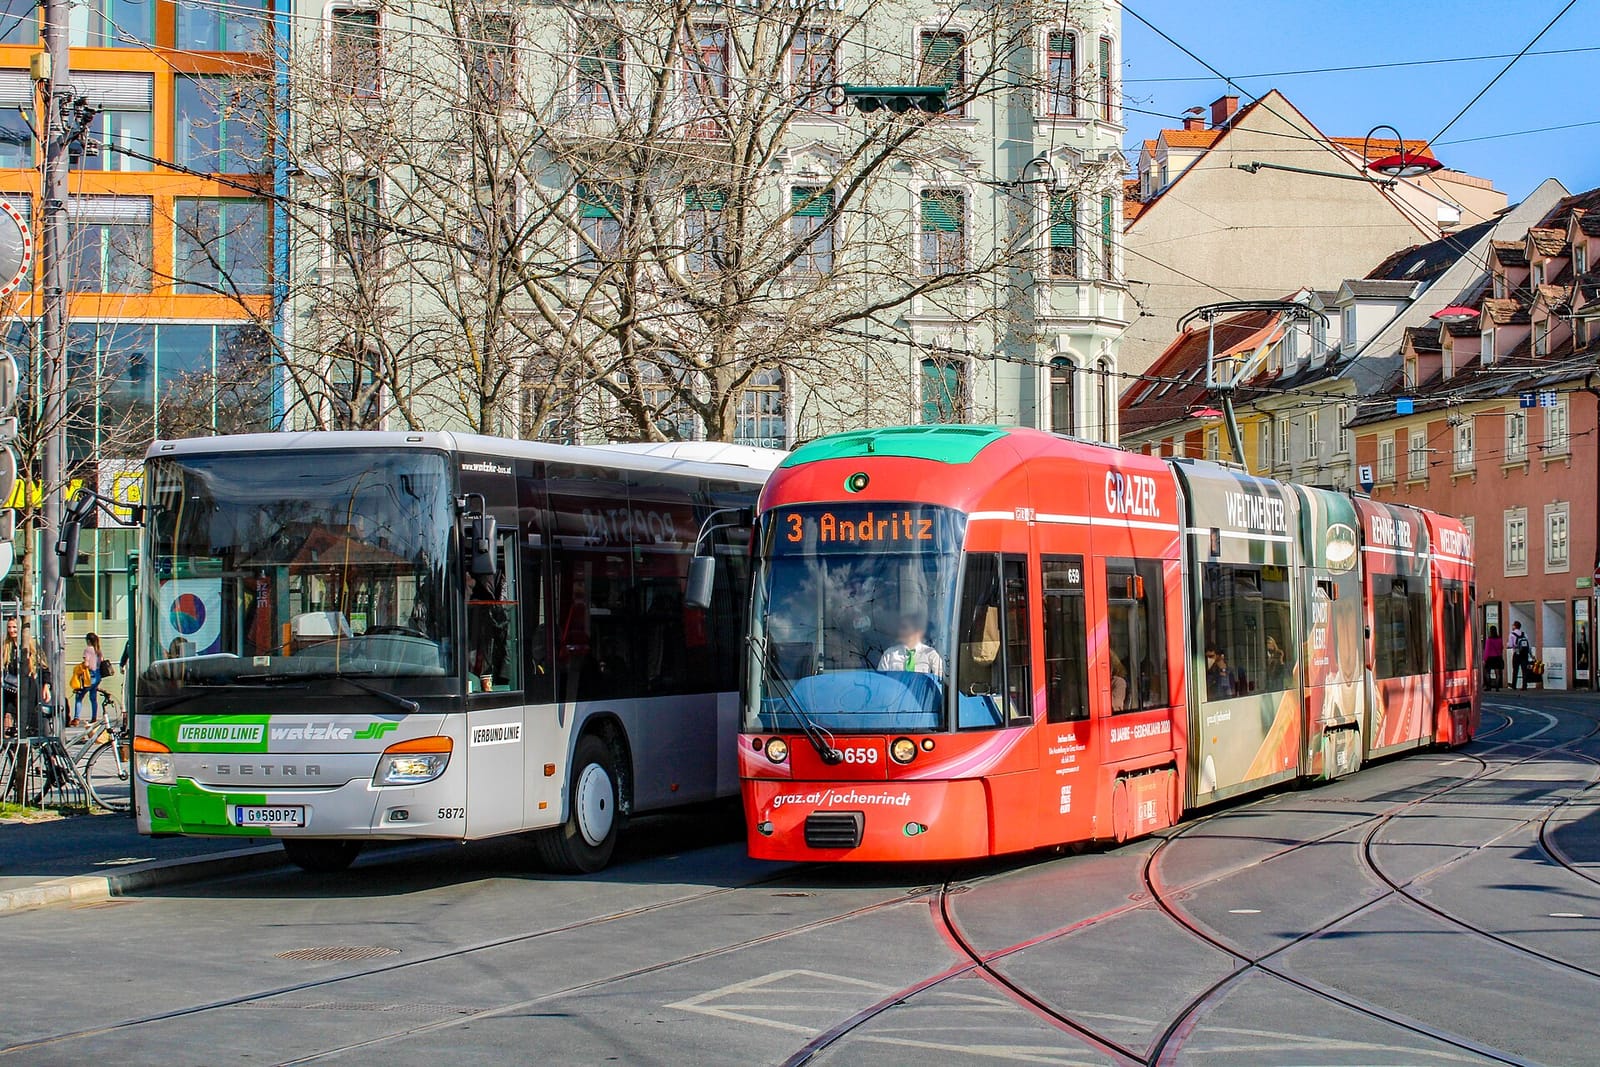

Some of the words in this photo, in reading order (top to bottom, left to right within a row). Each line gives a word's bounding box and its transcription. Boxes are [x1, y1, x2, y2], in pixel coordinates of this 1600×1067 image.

[1362, 469, 1369, 480] E
[1105, 470, 1160, 518] GRAZER.
[1225, 490, 1288, 532] WELTMEISTER.
[786, 513, 803, 543] 3
[820, 511, 933, 542] Andritz
[1067, 568, 1080, 584] 659
[182, 727, 229, 740] VERBUND
[231, 727, 260, 740] LINIE
[271, 721, 352, 740] watzke
[473, 727, 503, 744] VERBUND
[503, 726, 520, 741] LINIE
[844, 747, 878, 764] 659
[217, 764, 321, 776] SETRA
[773, 788, 911, 808] graz.at/jochenrindt
[262, 810, 282, 821] 590
[285, 809, 297, 821] PZ
[438, 808, 465, 819] 5872
